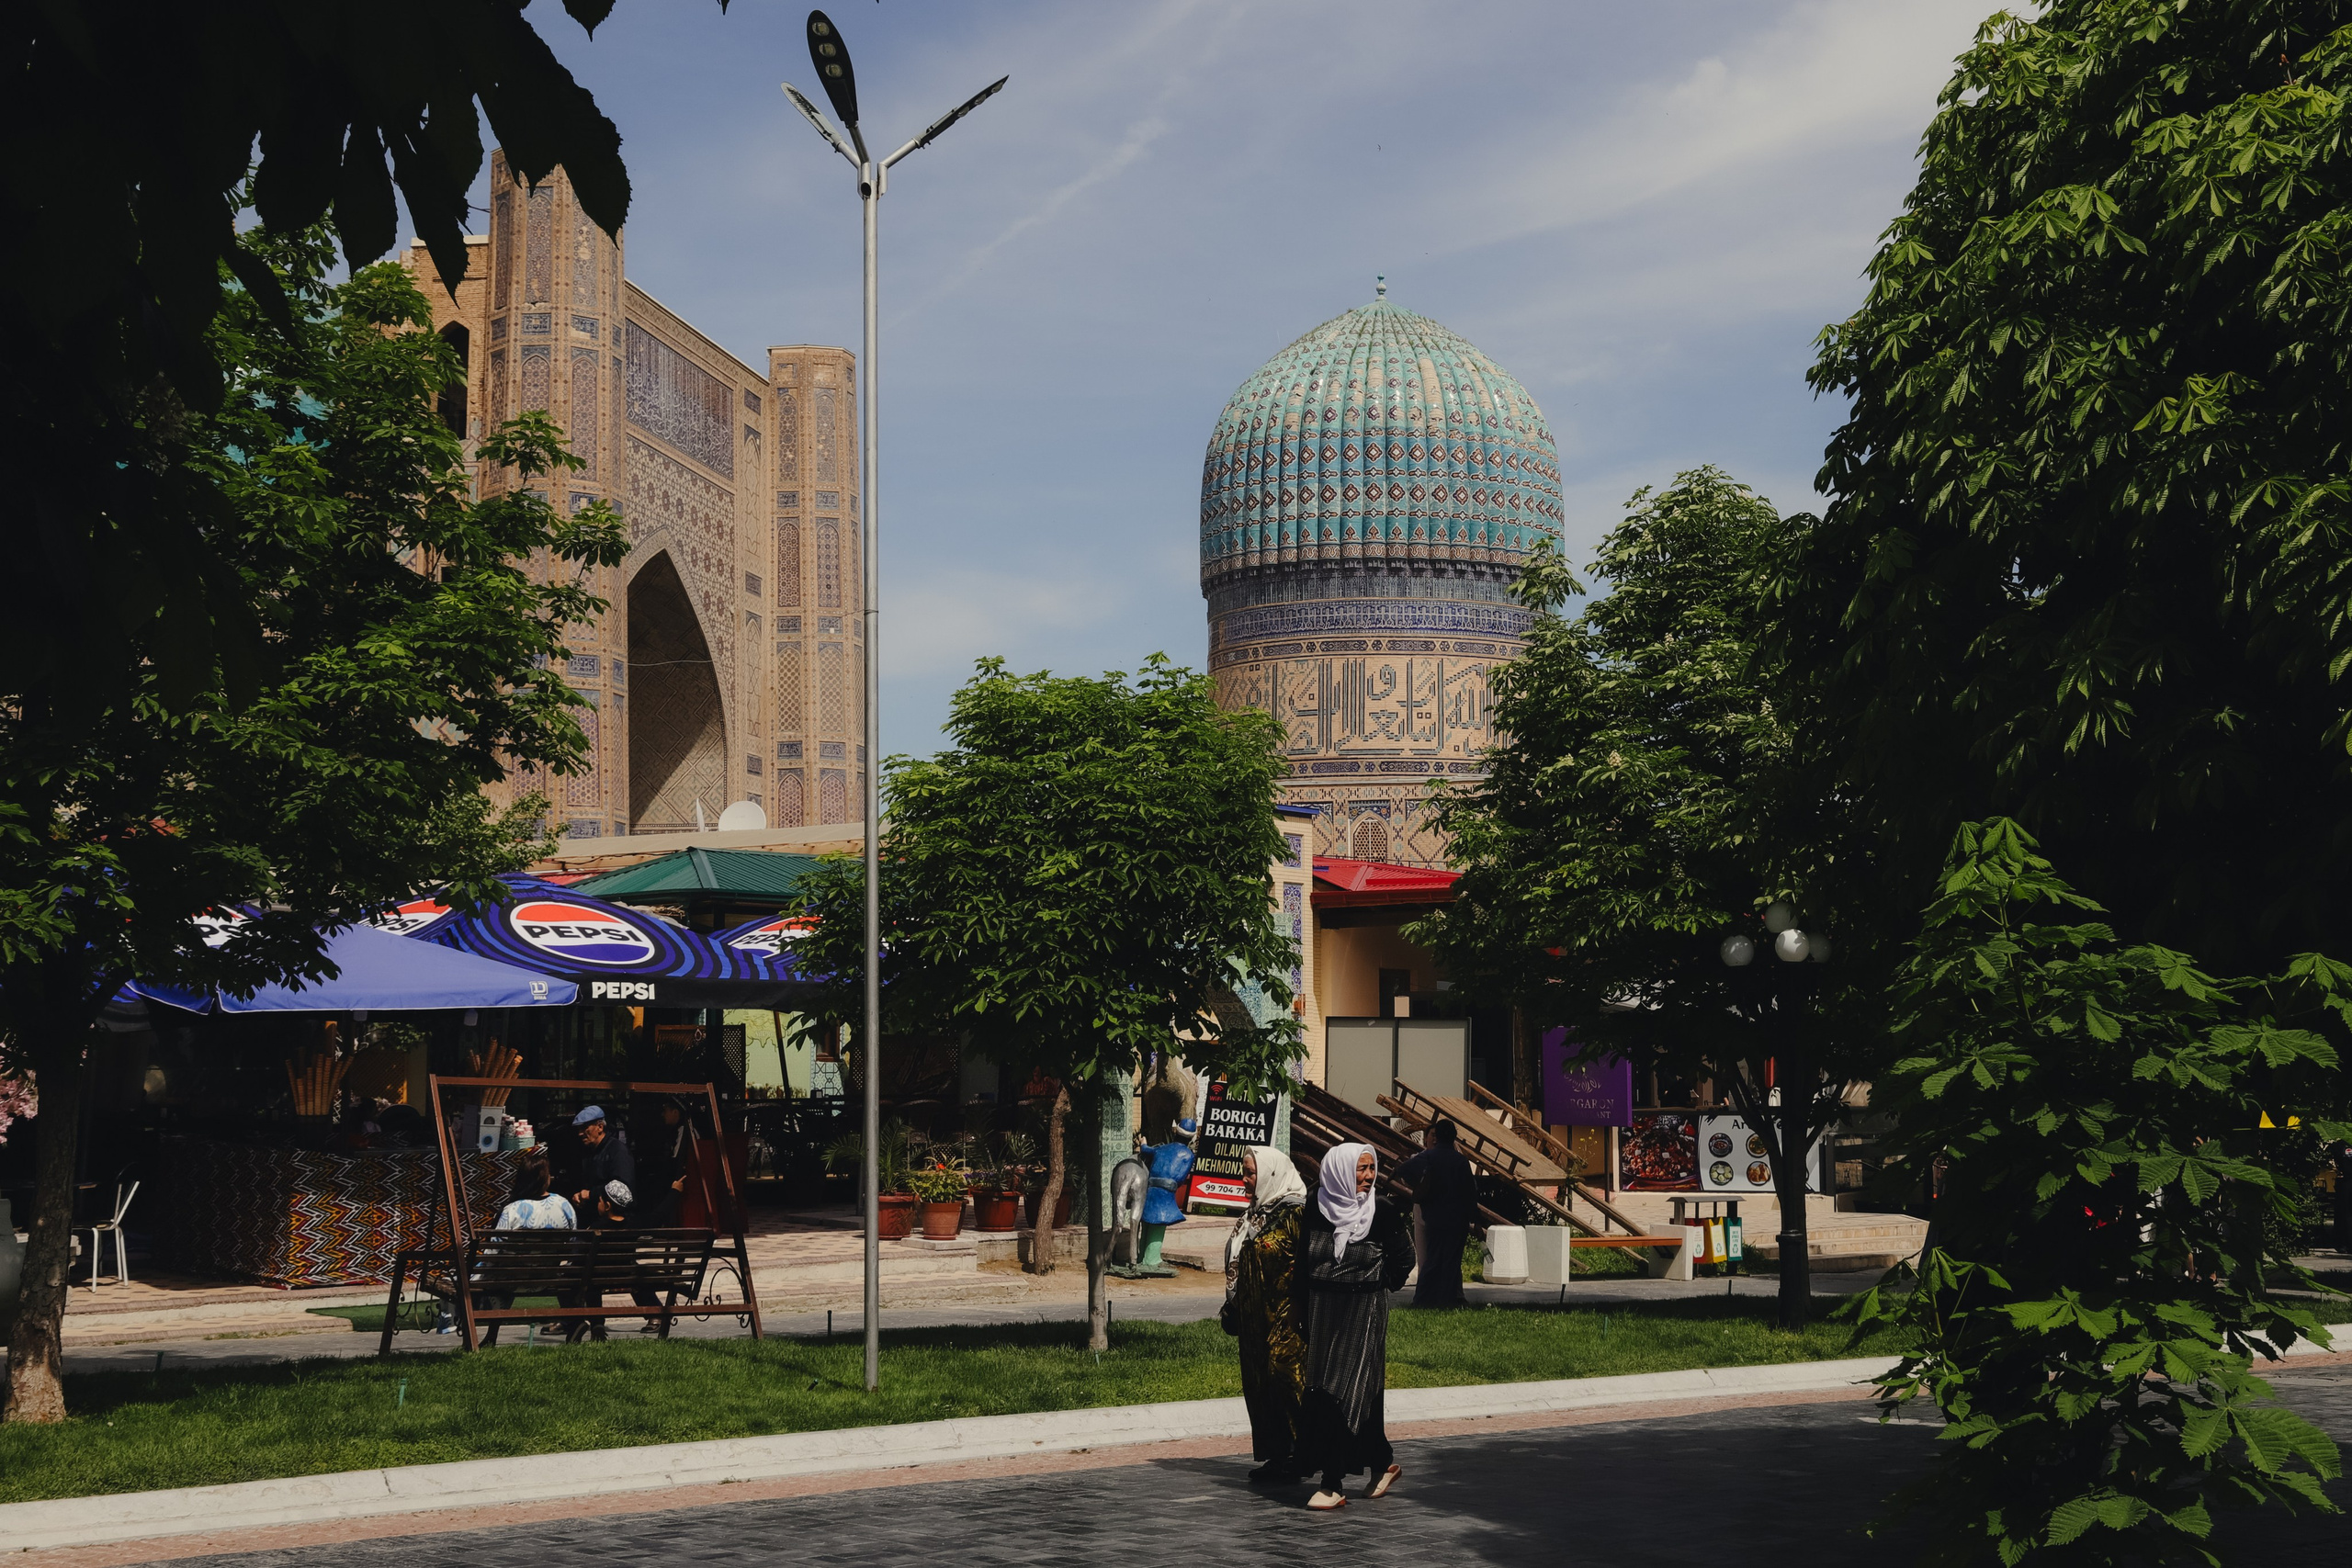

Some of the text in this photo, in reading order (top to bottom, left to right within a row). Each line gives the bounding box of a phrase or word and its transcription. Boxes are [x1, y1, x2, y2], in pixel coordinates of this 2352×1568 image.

[522, 925, 643, 942] PEPSI
[734, 935, 797, 947] PEPS
[592, 981, 655, 1000] PEPSI
[1210, 1108, 1266, 1126] BORIGA
[1204, 1123, 1266, 1142] BARAKA
[1215, 1142, 1245, 1158] OILAVI
[1195, 1157, 1244, 1176] MEHMONX
[1218, 1186, 1233, 1194] 704
